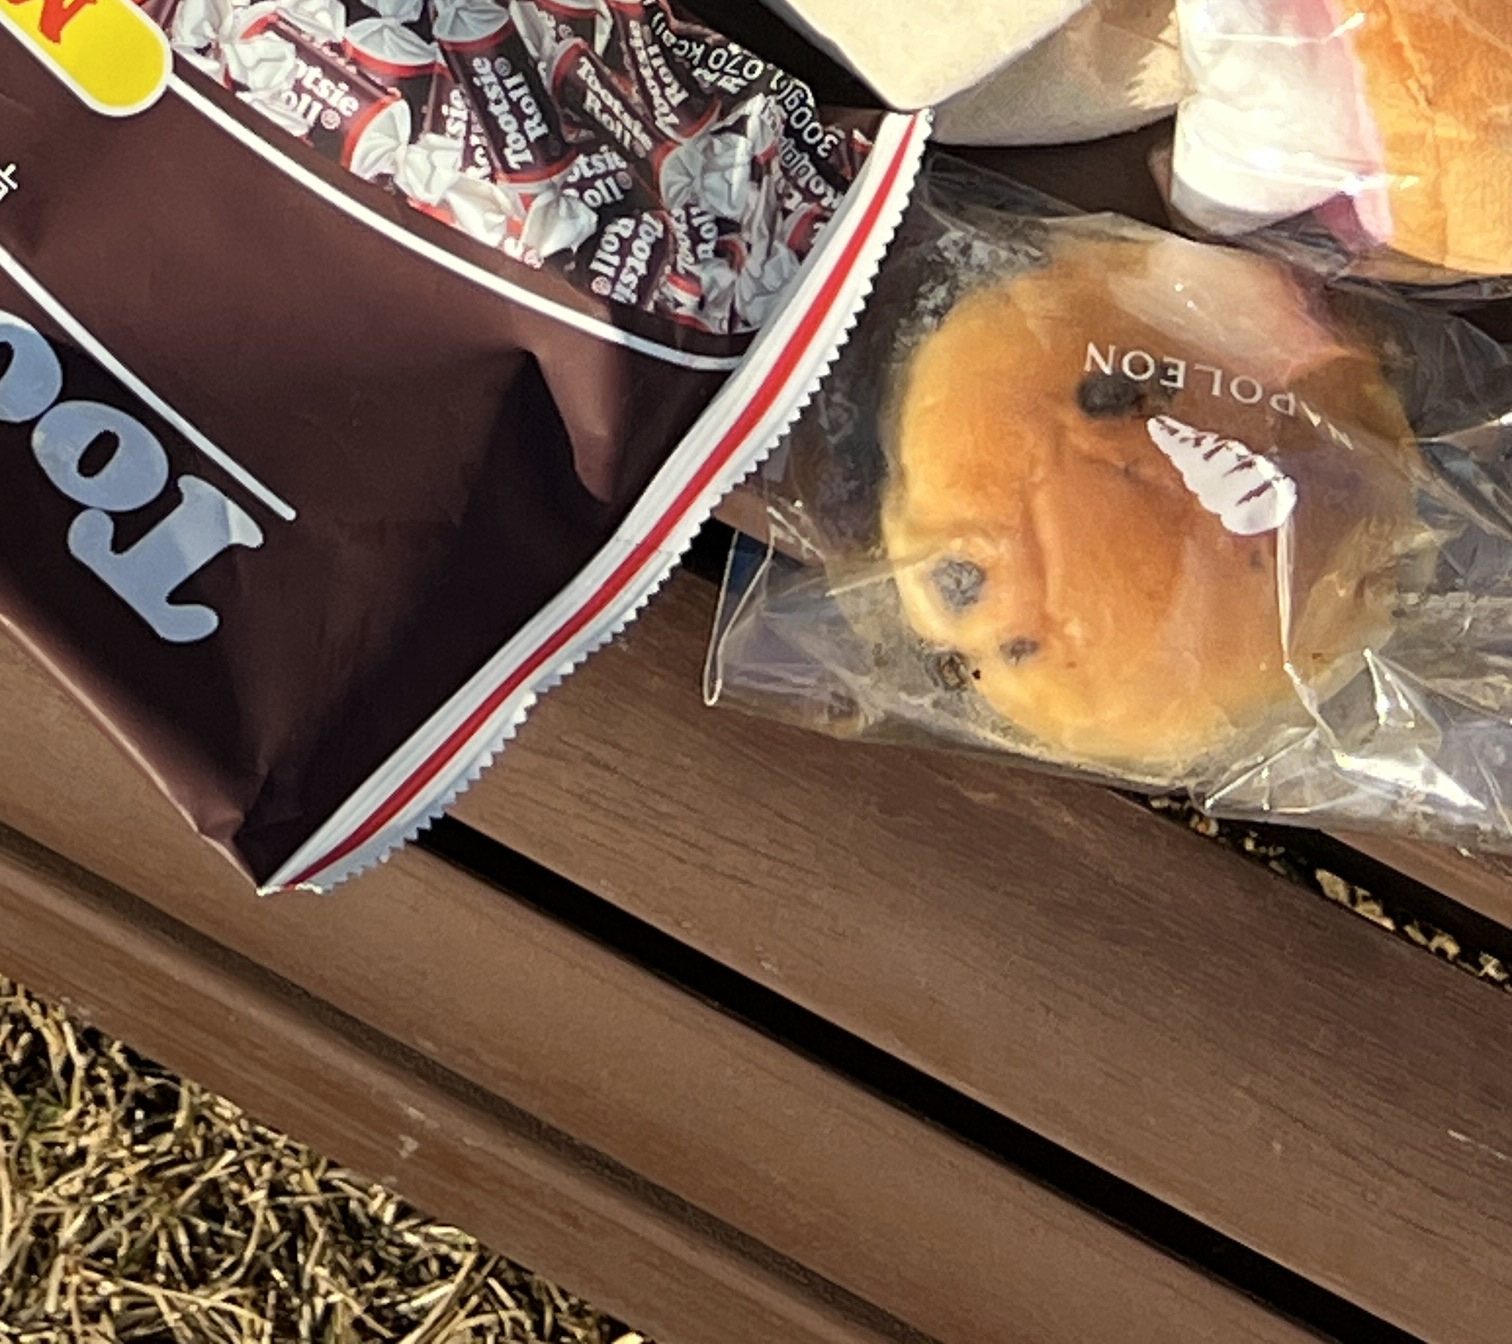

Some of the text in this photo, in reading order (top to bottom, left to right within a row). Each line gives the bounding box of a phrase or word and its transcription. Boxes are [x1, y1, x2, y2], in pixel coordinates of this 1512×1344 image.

[465, 52, 532, 169] Tootsie
[502, 67, 551, 141] Roll
[562, 52, 668, 155] Tootsie
[575, 86, 640, 148] Roll
